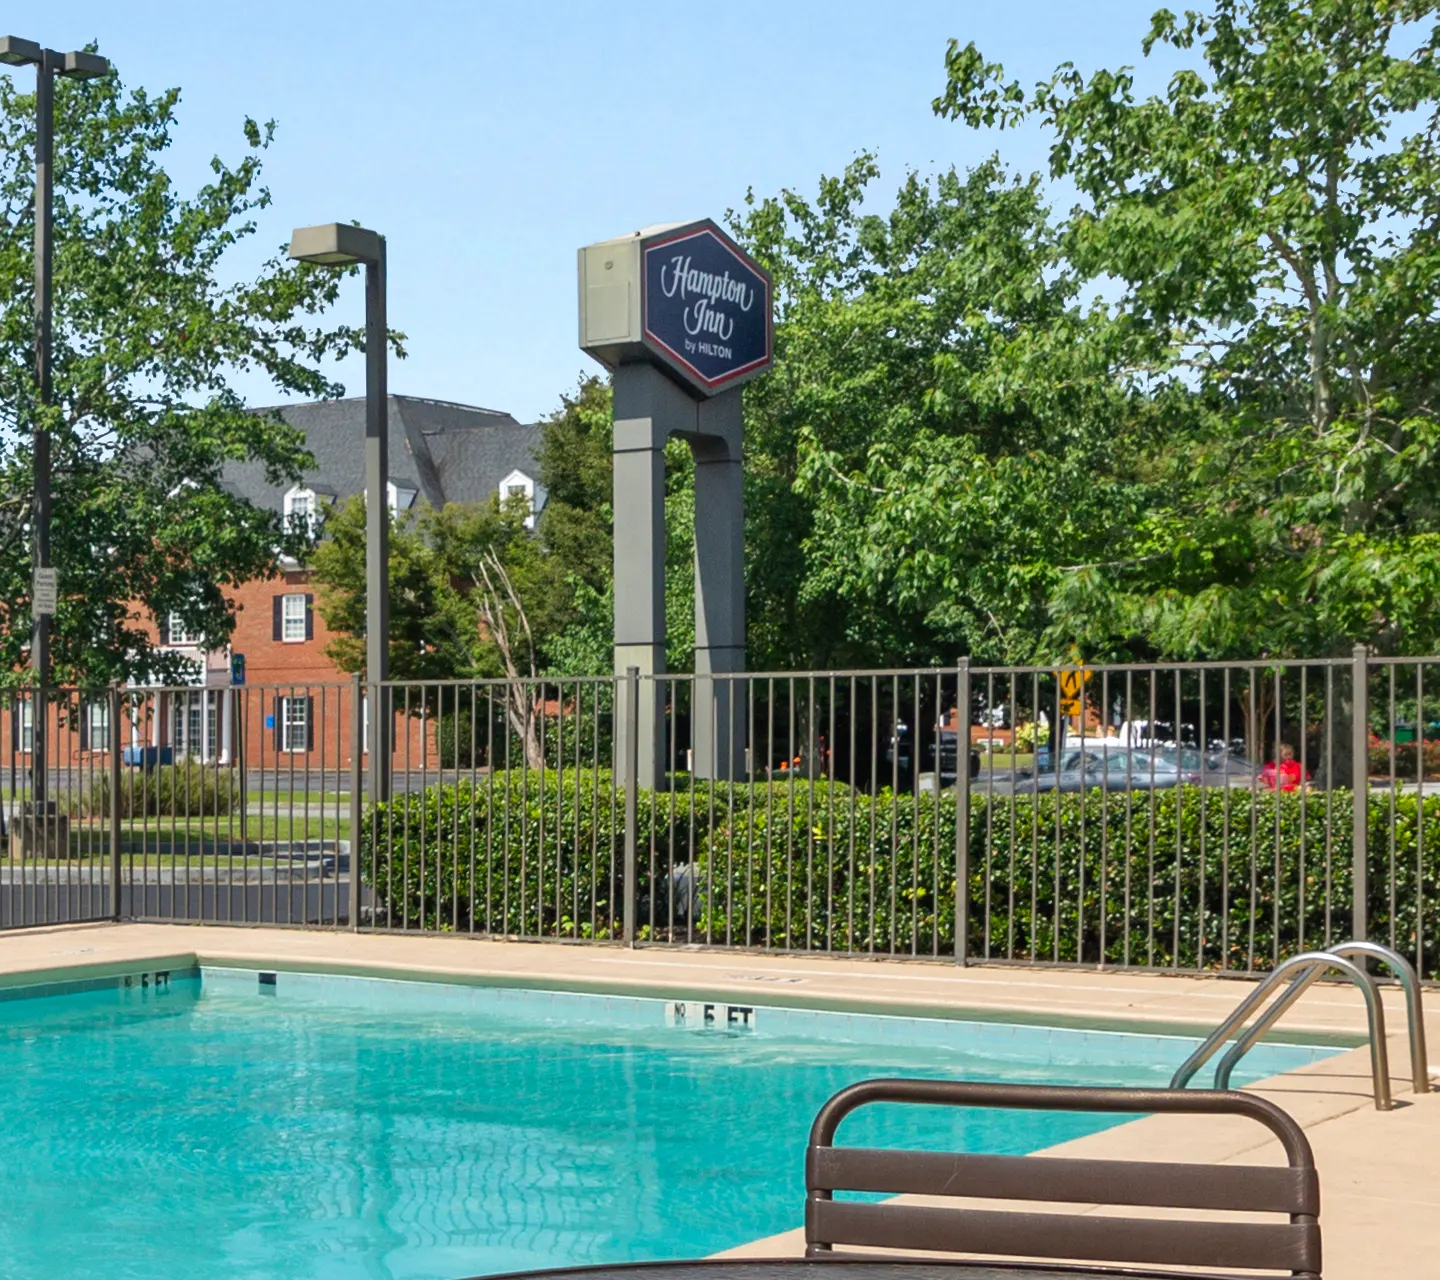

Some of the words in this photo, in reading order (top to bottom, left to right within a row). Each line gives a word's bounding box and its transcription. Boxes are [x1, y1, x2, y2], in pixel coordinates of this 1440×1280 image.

[661, 256, 754, 311] Hampton
[683, 299, 733, 340] Inn
[684, 338, 697, 354] by
[698, 341, 732, 359] HILTON
[727, 1006, 754, 1024] FT
